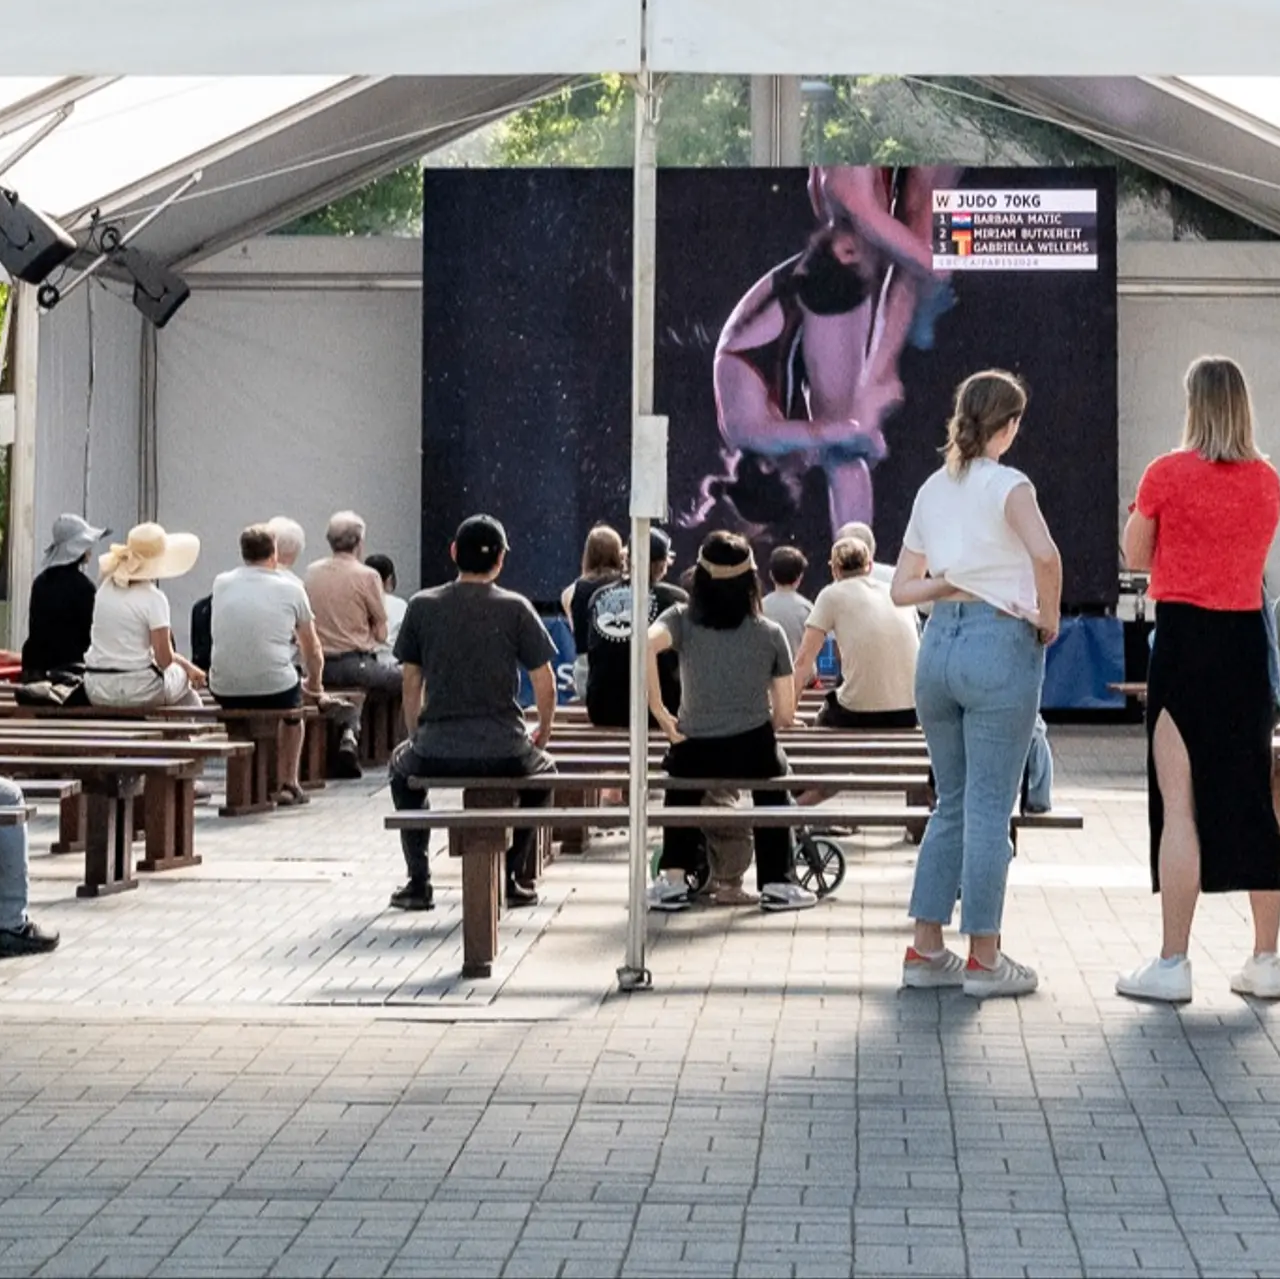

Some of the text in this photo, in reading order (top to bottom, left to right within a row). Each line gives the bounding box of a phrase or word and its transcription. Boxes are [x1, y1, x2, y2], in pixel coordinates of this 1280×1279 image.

[935, 195, 1041, 208] W JUDO 70KG
[939, 214, 1062, 225] 1 BARBARA MATIC
[939, 228, 1082, 240] 2 MIRIAM BUTKEREIT
[939, 242, 1089, 253] 3 GABRIELLA WILLEMS
